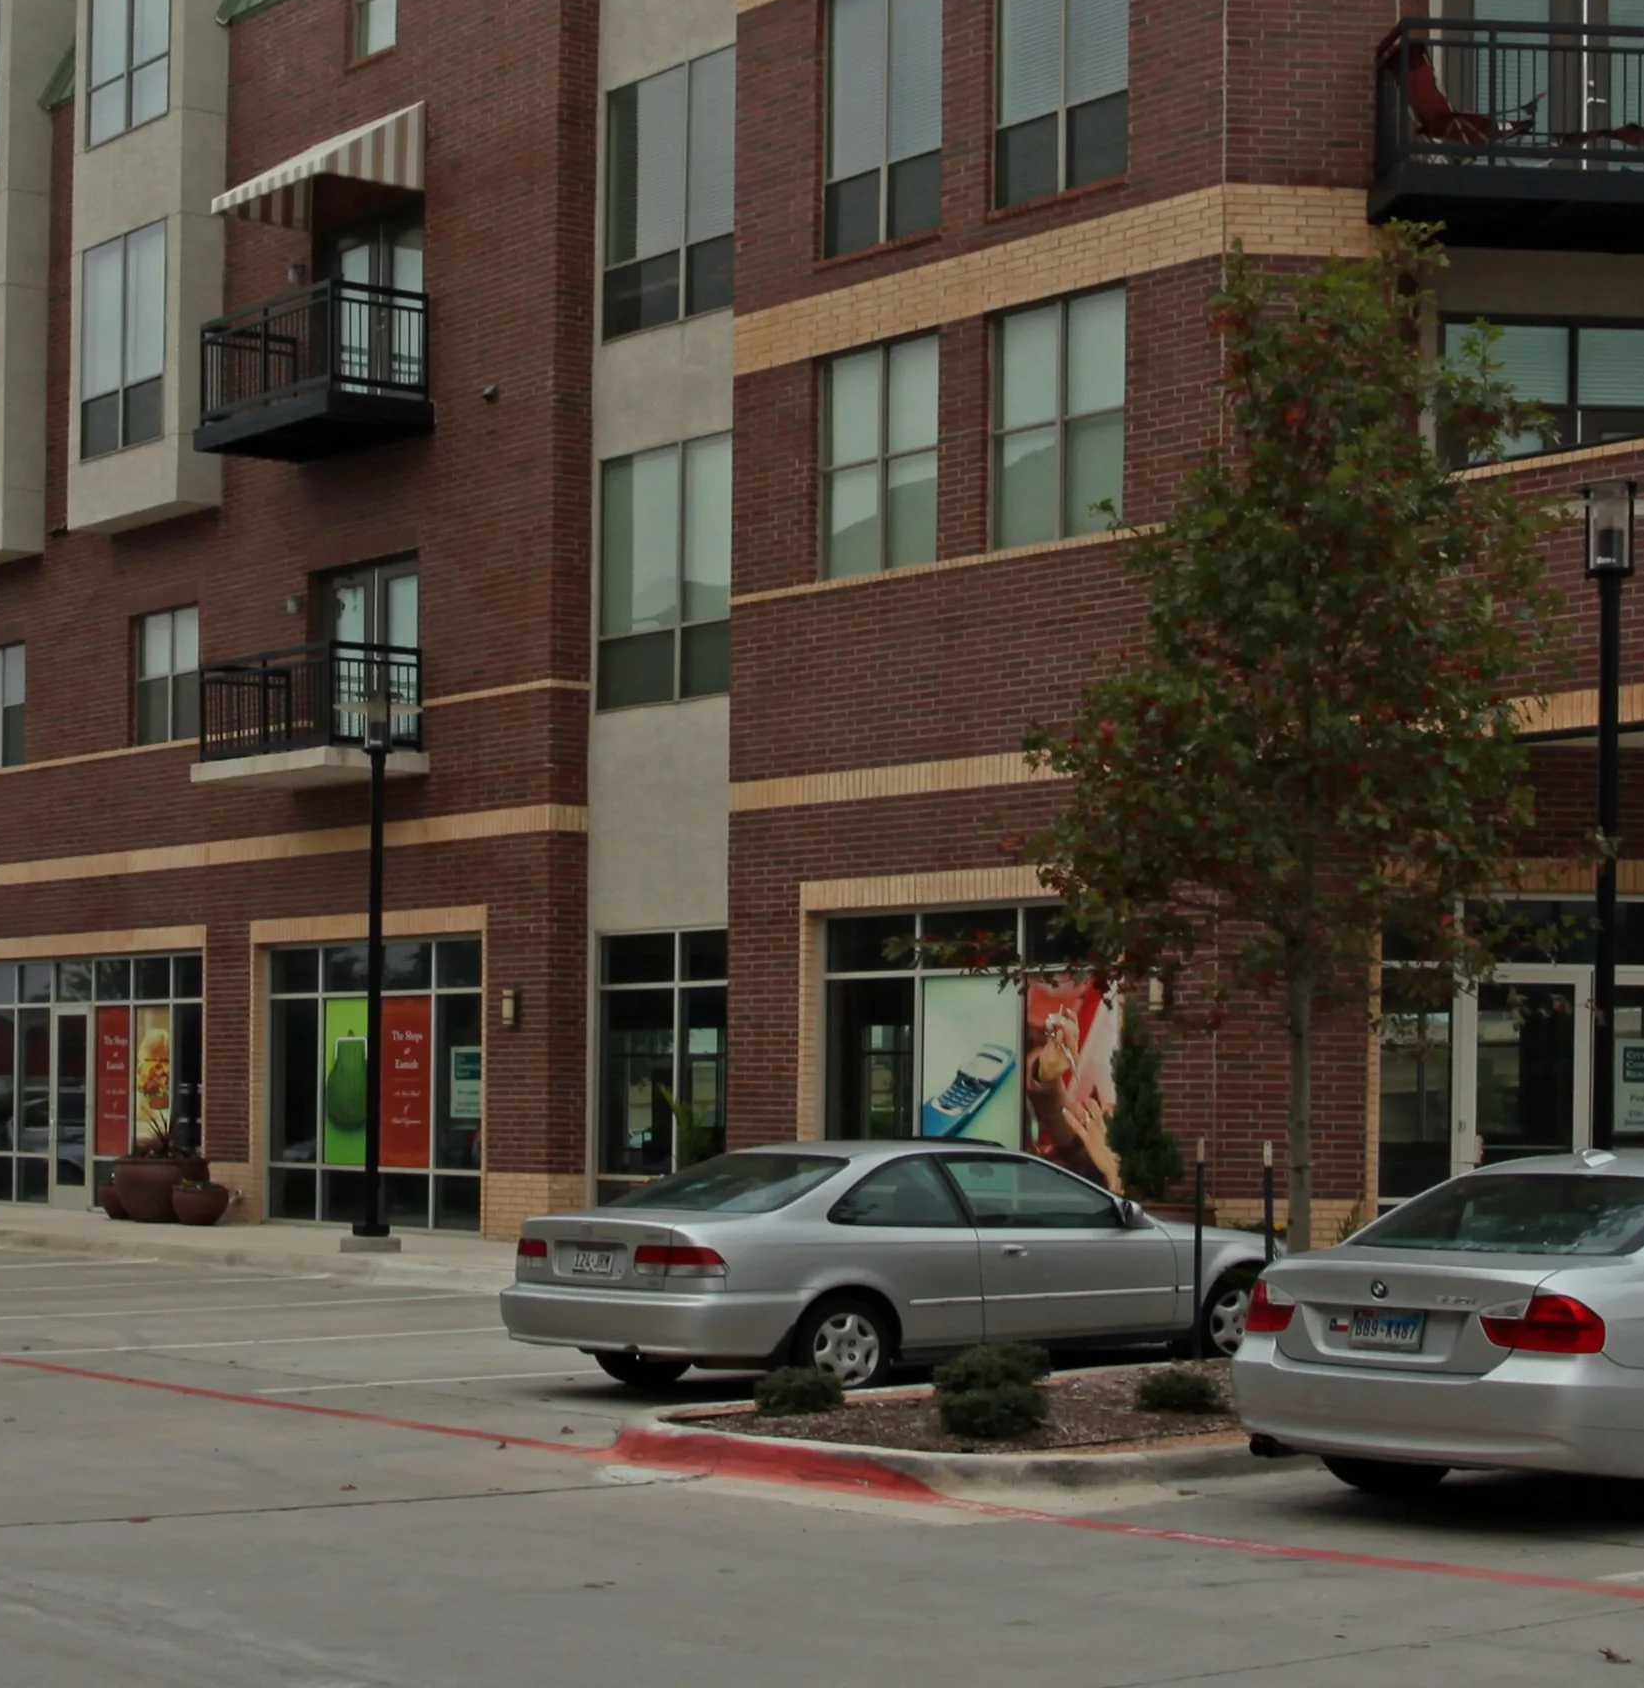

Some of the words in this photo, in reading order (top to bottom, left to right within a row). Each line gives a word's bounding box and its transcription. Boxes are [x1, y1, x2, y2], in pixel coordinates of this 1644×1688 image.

[391, 1030, 404, 1041] The
[405, 1030, 424, 1044] Shops
[1630, 1093, 1644, 1103] For
